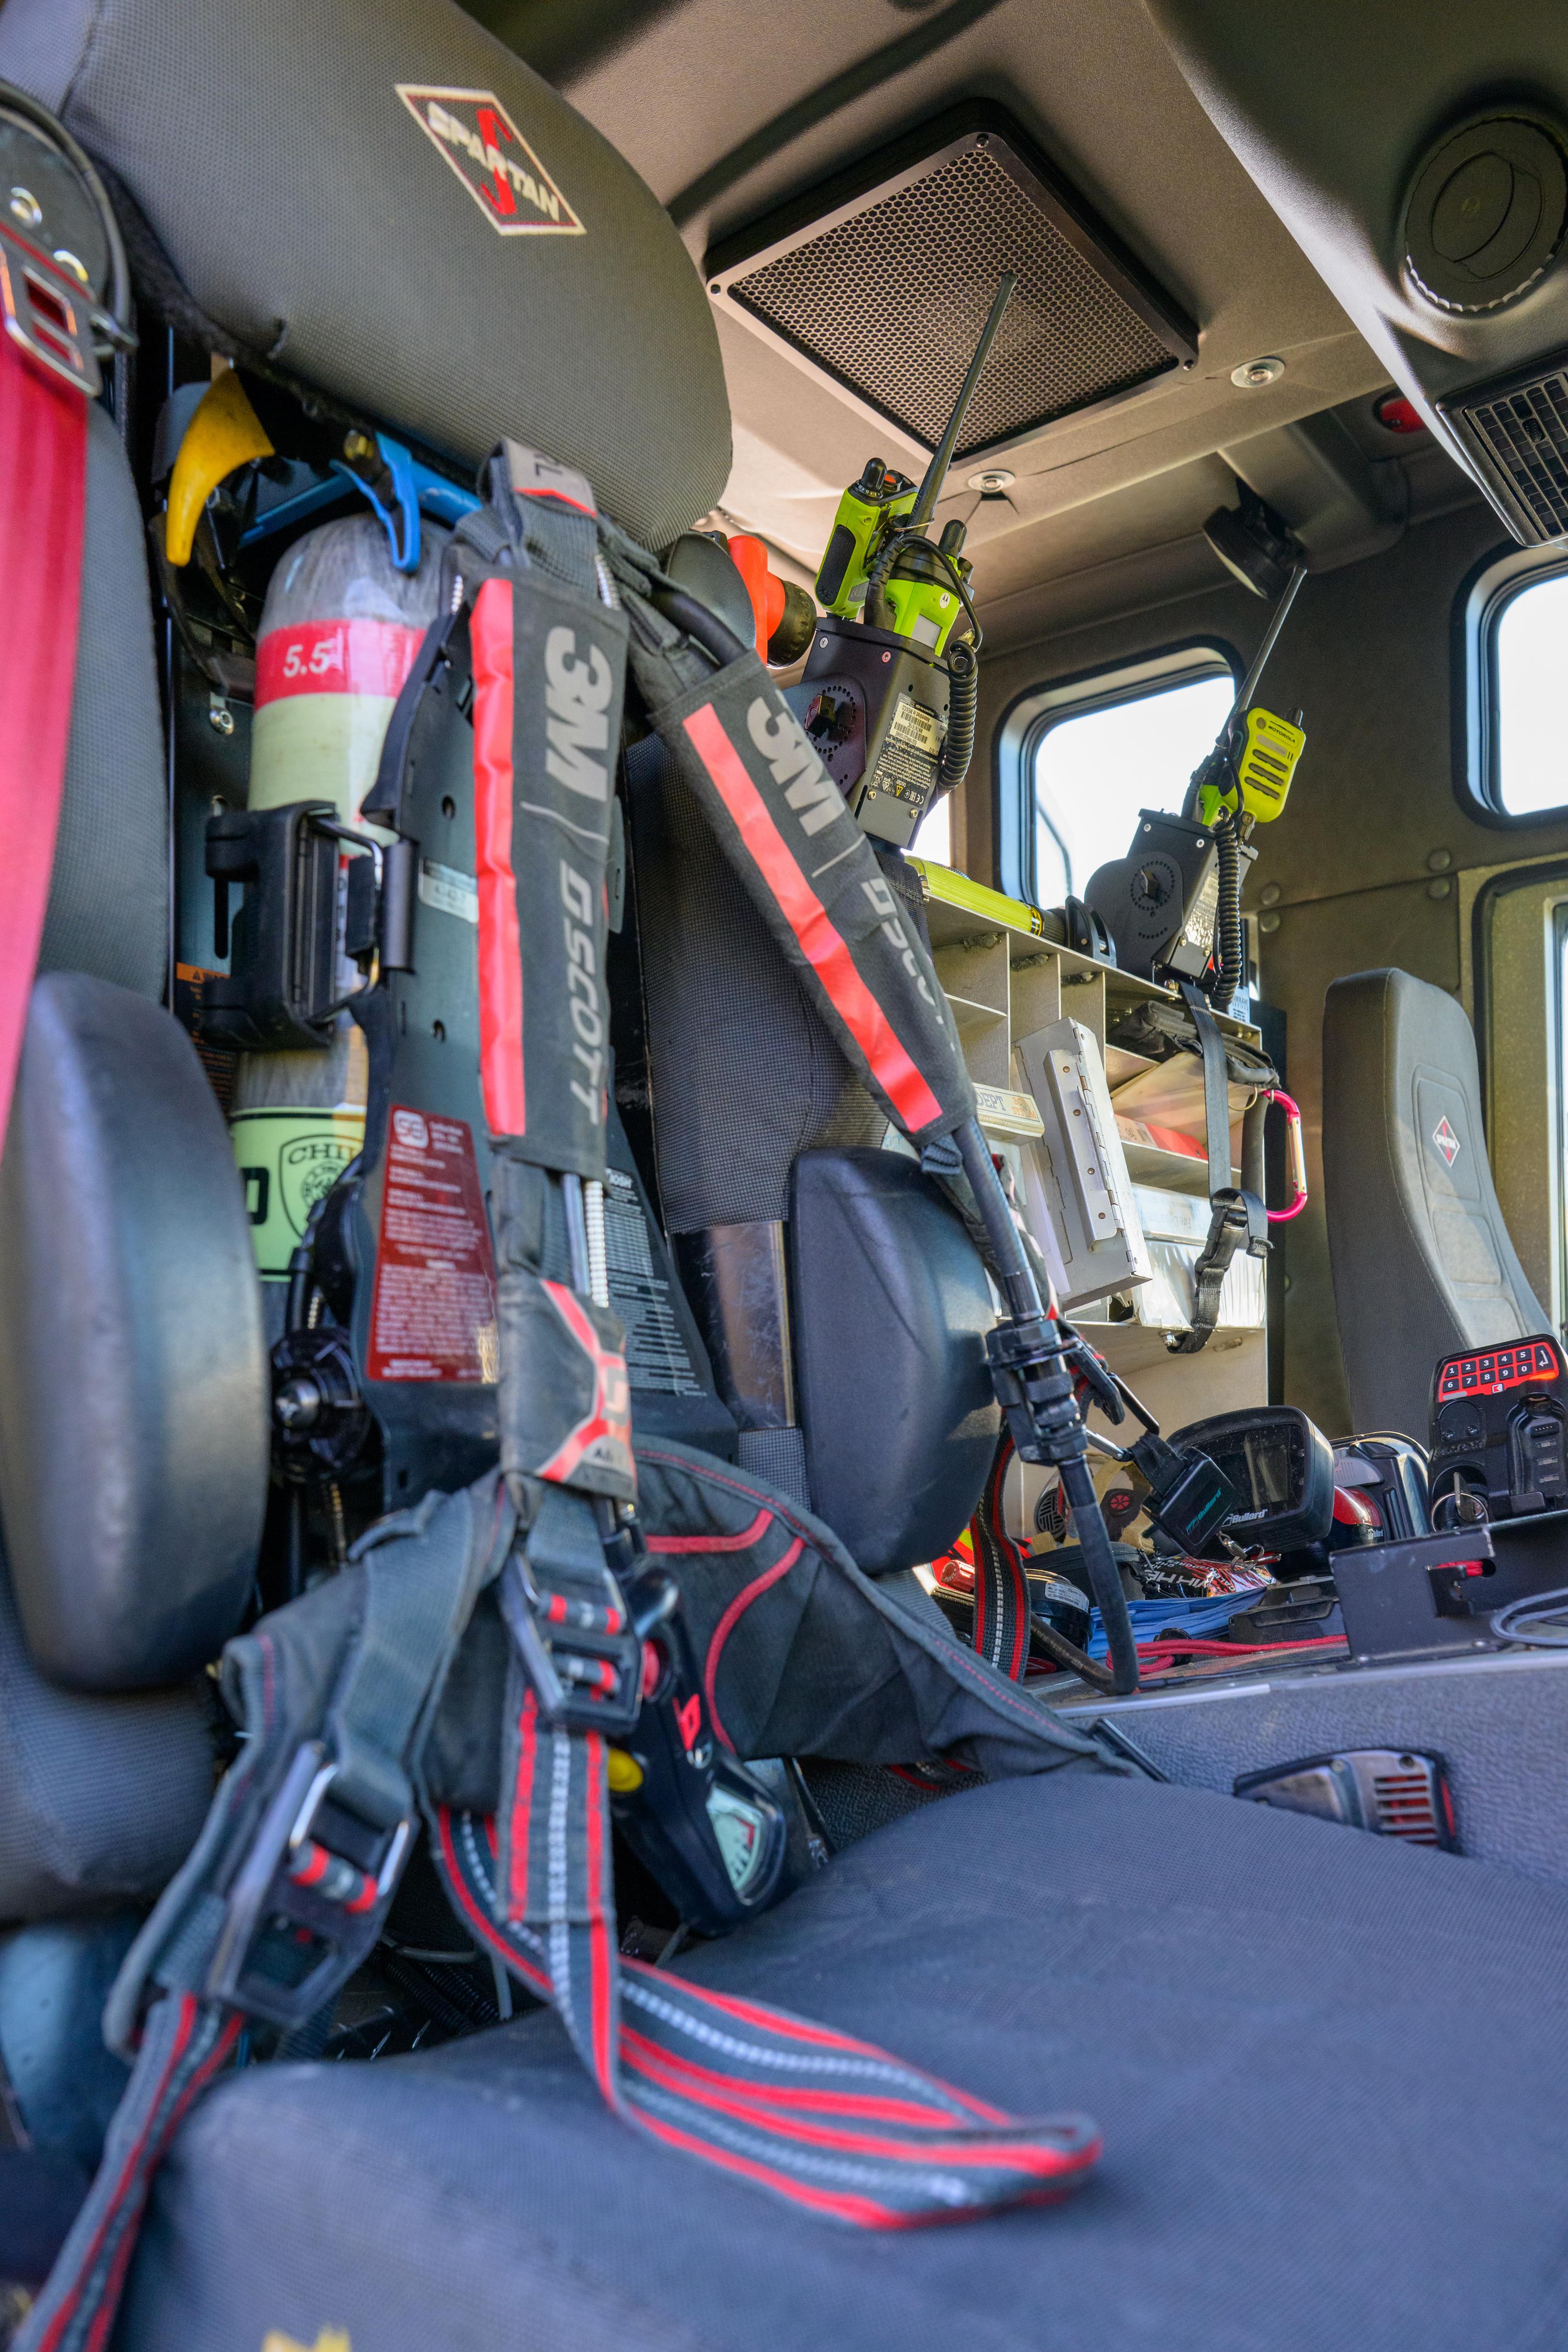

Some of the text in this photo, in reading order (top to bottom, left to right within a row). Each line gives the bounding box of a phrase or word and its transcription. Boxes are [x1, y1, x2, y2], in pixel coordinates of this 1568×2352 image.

[283, 641, 333, 678] 5.5
[544, 626, 613, 802] 3M
[902, 705, 913, 714] MEXICO
[915, 712, 930, 723] Assembled
[1268, 725, 1296, 743] MOTOROLA
[746, 696, 846, 837] 3M
[564, 916, 604, 1125] SCOTT
[1232, 1509, 1267, 1524] Bullard
